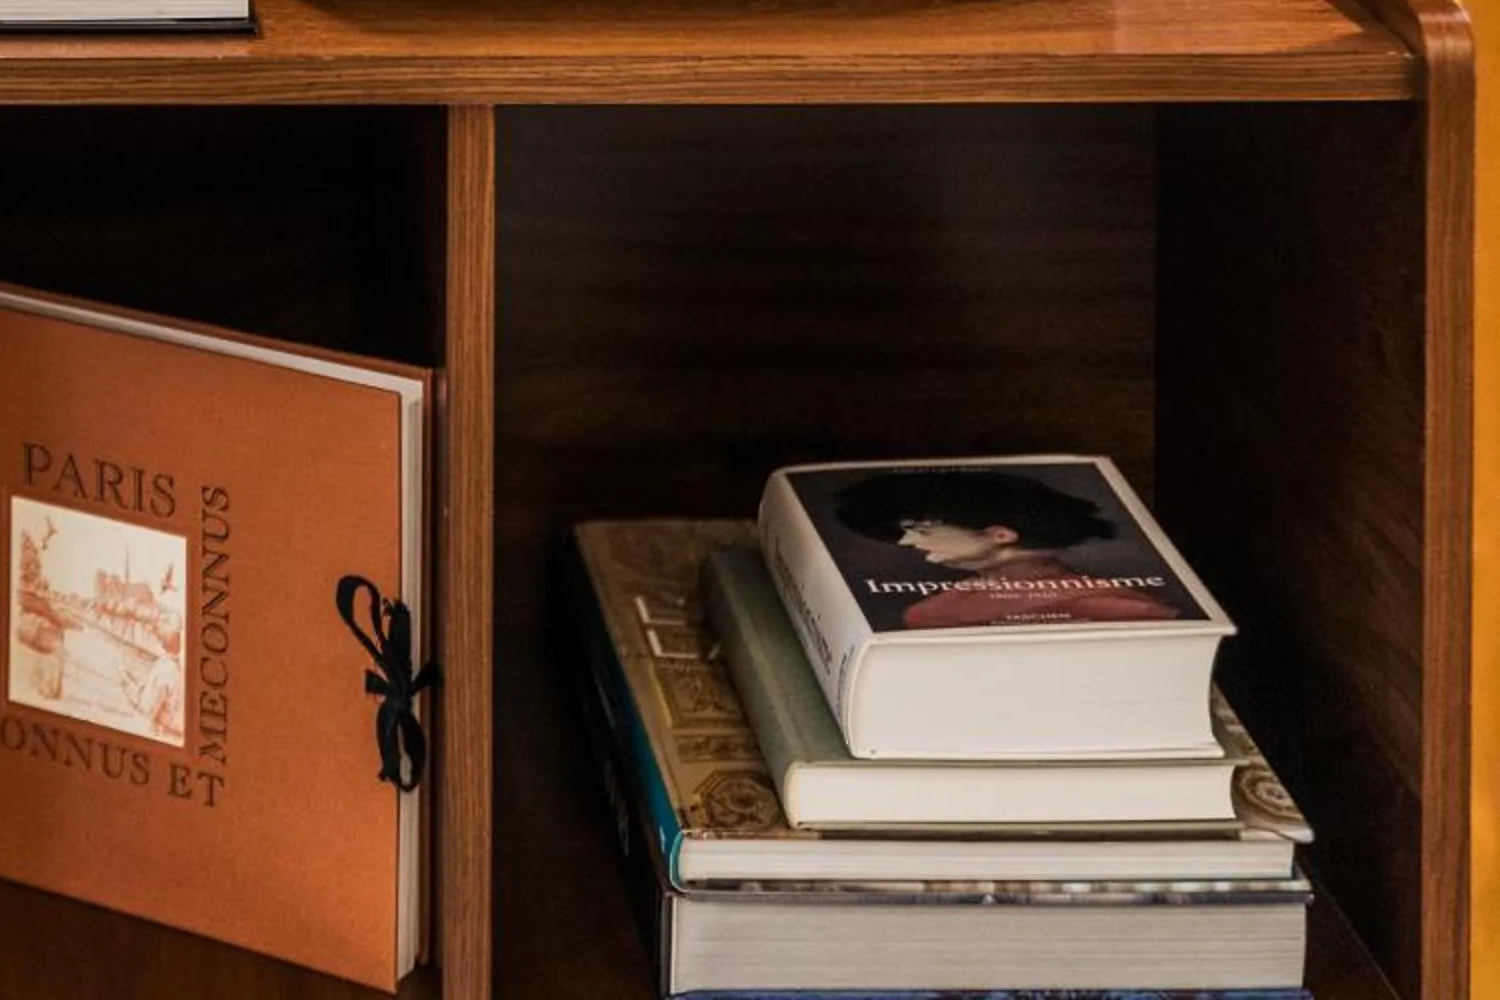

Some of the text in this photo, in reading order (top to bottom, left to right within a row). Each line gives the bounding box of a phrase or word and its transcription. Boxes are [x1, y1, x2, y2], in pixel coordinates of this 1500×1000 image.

[22, 441, 177, 519] PARIS
[864, 574, 1167, 597] Impressionnisme
[198, 485, 230, 765] MECONNUS
[166, 762, 225, 808] ET
